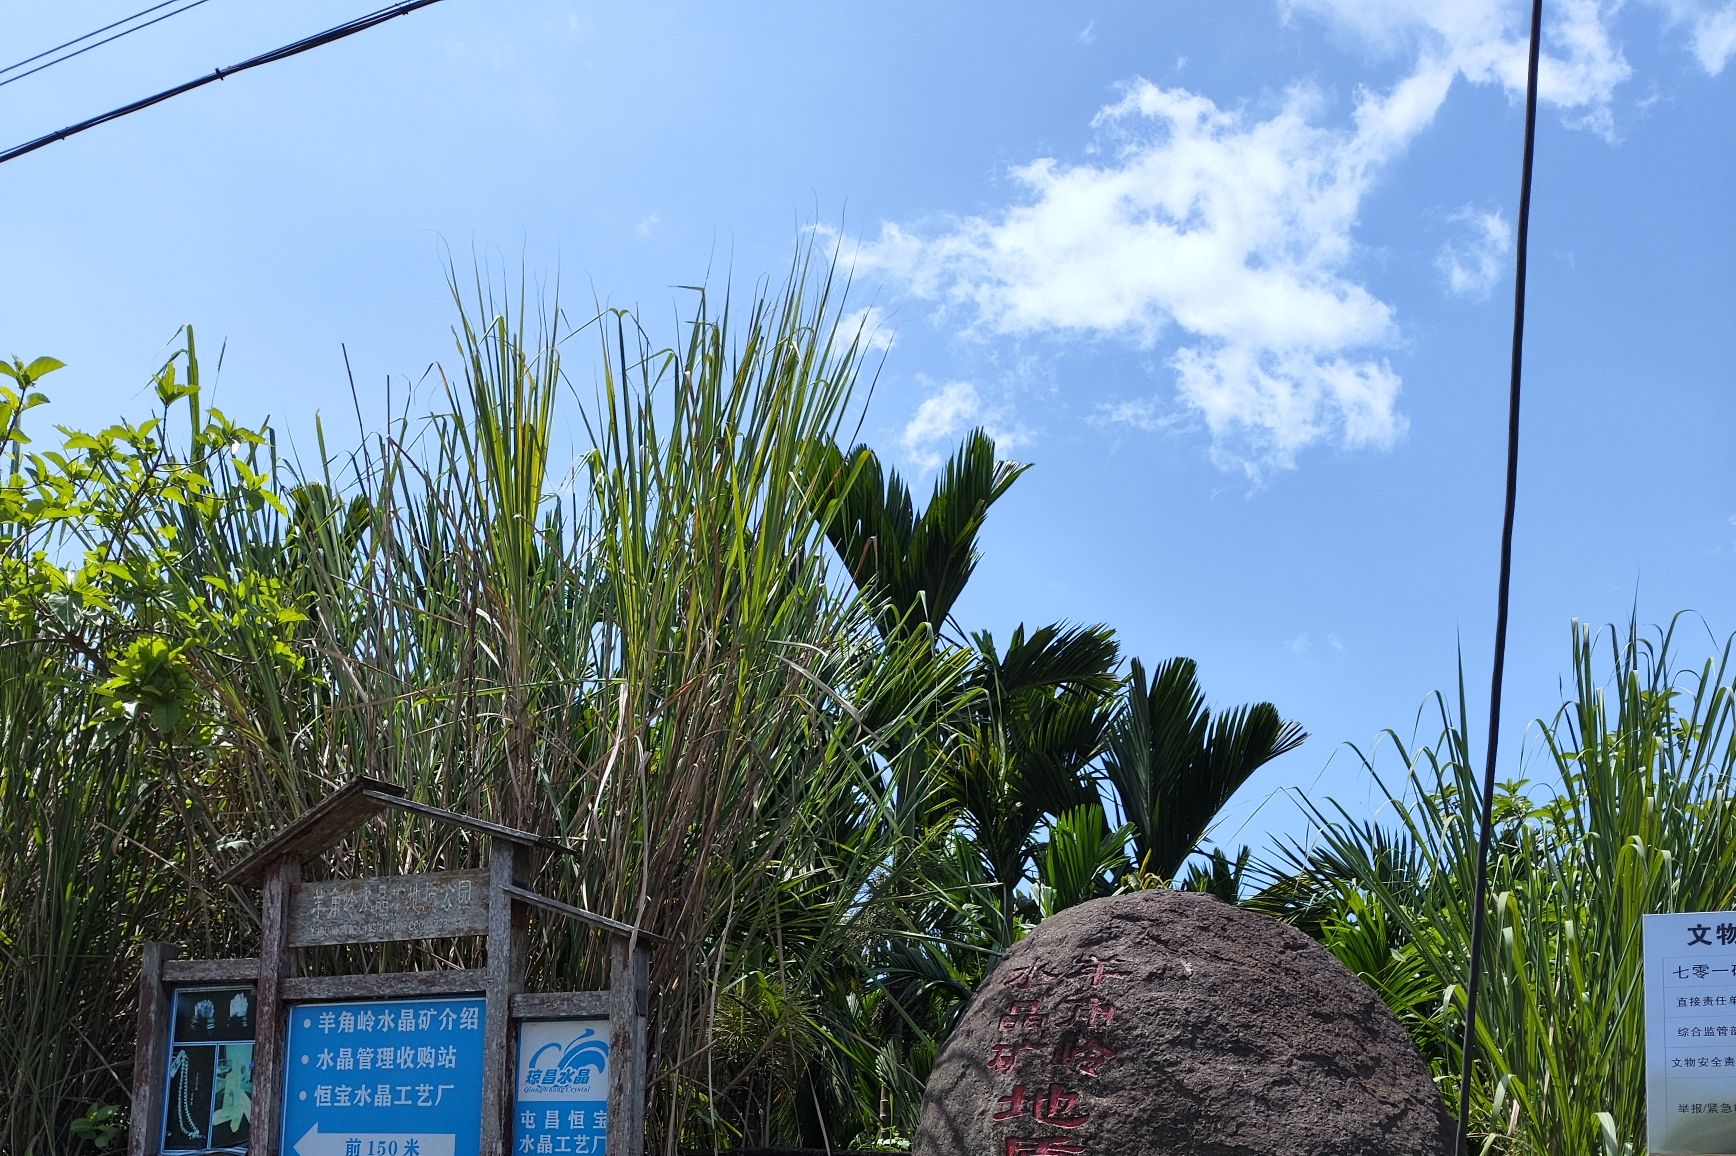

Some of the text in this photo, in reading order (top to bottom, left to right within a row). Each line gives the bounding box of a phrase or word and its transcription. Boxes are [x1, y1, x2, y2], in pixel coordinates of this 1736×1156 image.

[1687, 923, 1736, 946] 文物
[318, 1007, 479, 1034] 羊角岭水晶矿介绍
[316, 1046, 457, 1071] 水晶管理收购站
[1672, 1057, 1735, 1068] 文物安全责
[526, 1069, 591, 1085] 琼昌水晶
[314, 1083, 455, 1108] 恒宝水晶工艺厂
[1678, 1102, 1736, 1115] 举报/紧急
[520, 1109, 607, 1130] 屯昌恒宝
[518, 1134, 607, 1154] 水晶工艺厂
